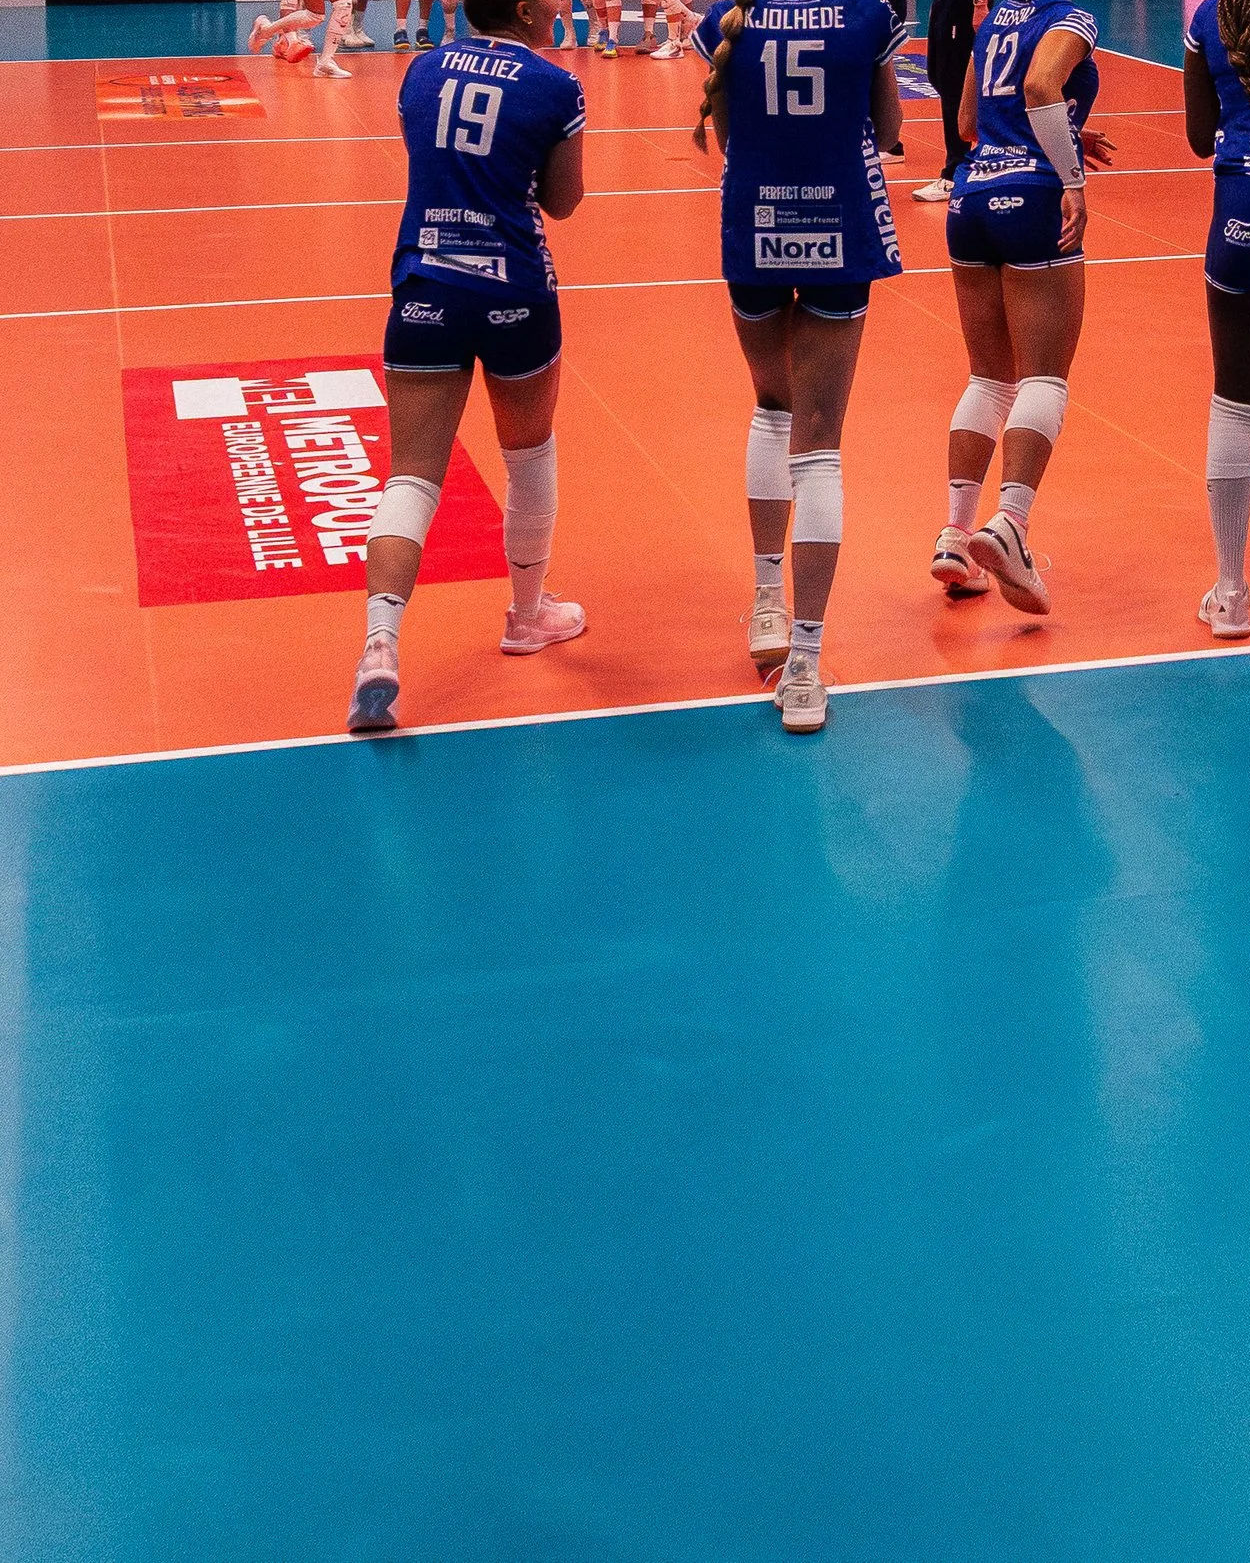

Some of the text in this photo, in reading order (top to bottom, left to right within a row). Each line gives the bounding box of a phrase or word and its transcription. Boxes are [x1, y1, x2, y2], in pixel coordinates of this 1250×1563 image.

[440, 51, 524, 81] THILLIEZ
[760, 40, 825, 115] 15
[982, 31, 1019, 97] 12
[435, 78, 503, 156] 19
[759, 186, 835, 199] PERFECT GROUP
[988, 196, 1025, 210] GGP
[425, 208, 462, 223] PERFECT
[760, 235, 837, 259] Nord
[401, 301, 445, 322] Ford
[487, 307, 530, 324] GGP
[221, 421, 303, 572] EUROPÉENNE DE LILLE
[280, 414, 383, 566] MÉTROPOLE
